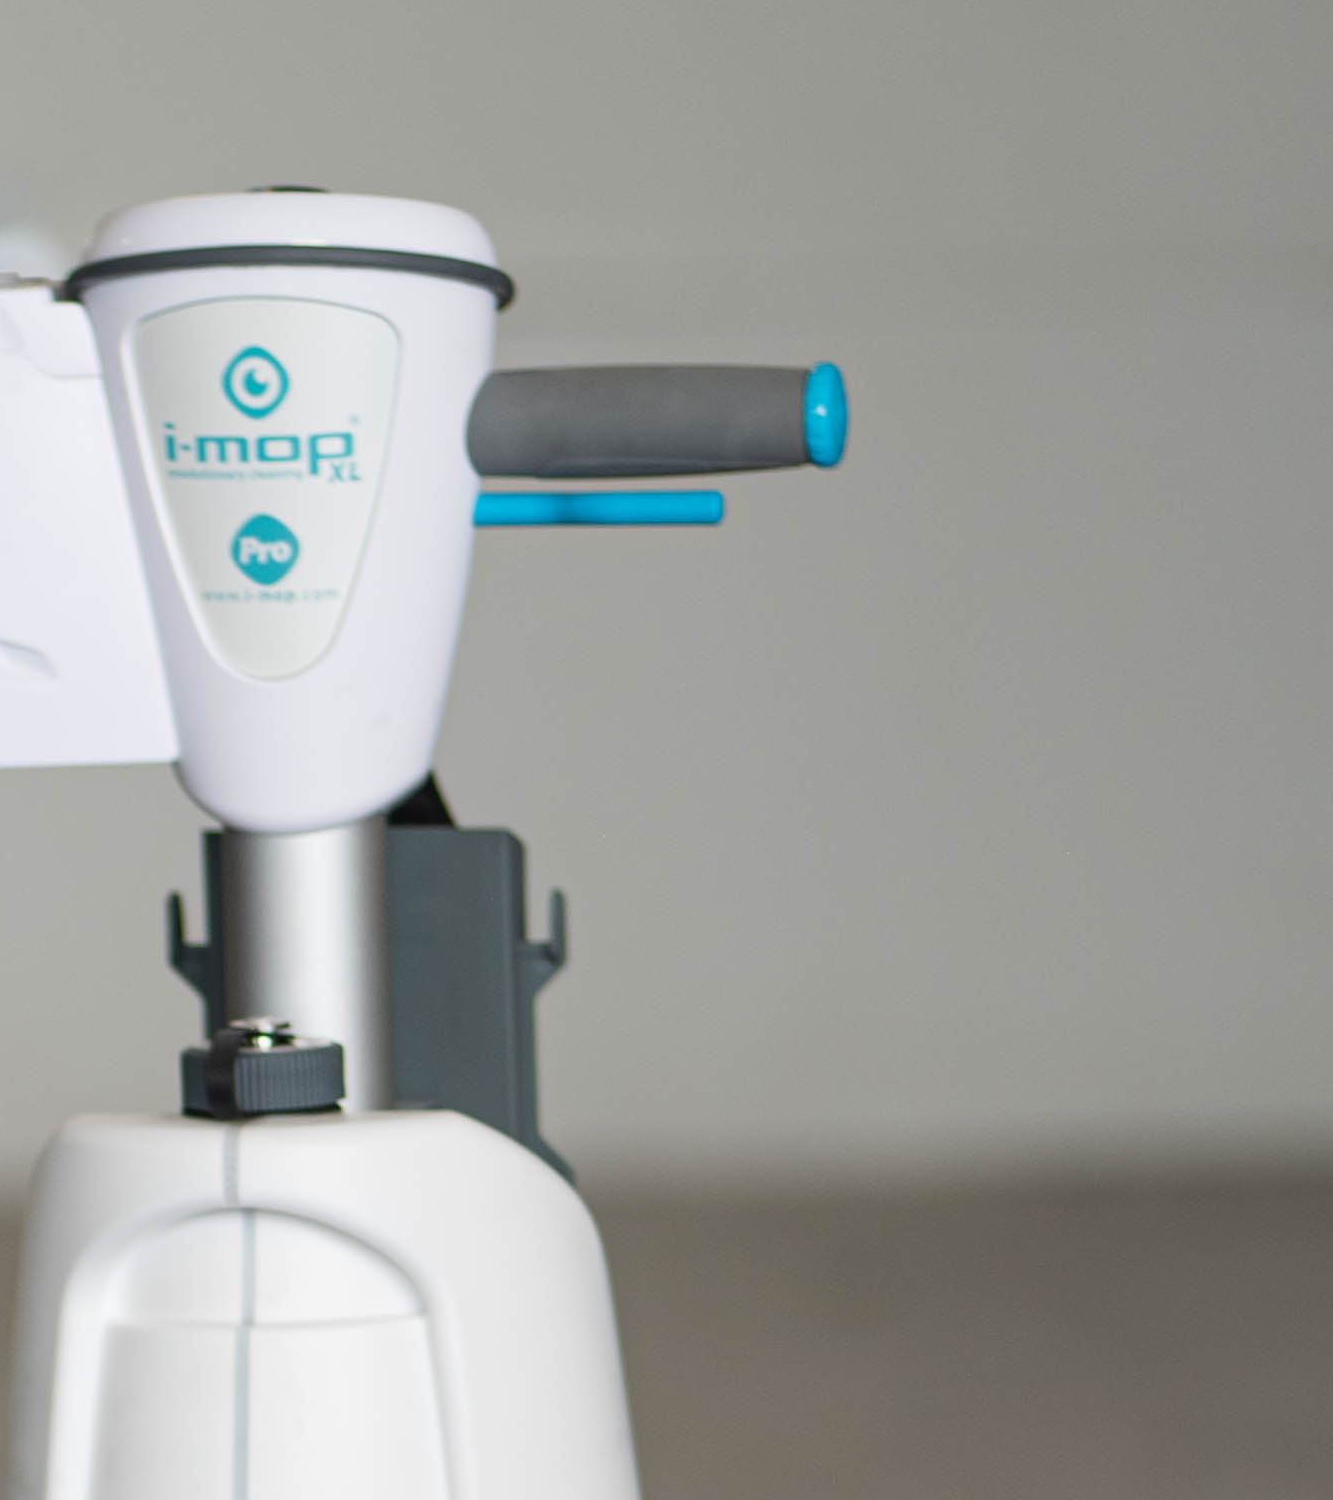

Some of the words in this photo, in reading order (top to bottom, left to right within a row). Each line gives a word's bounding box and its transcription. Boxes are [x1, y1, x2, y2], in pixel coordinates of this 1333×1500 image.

[163, 421, 354, 476] i-mop
[329, 463, 361, 482] XL
[239, 536, 293, 566] Pro
